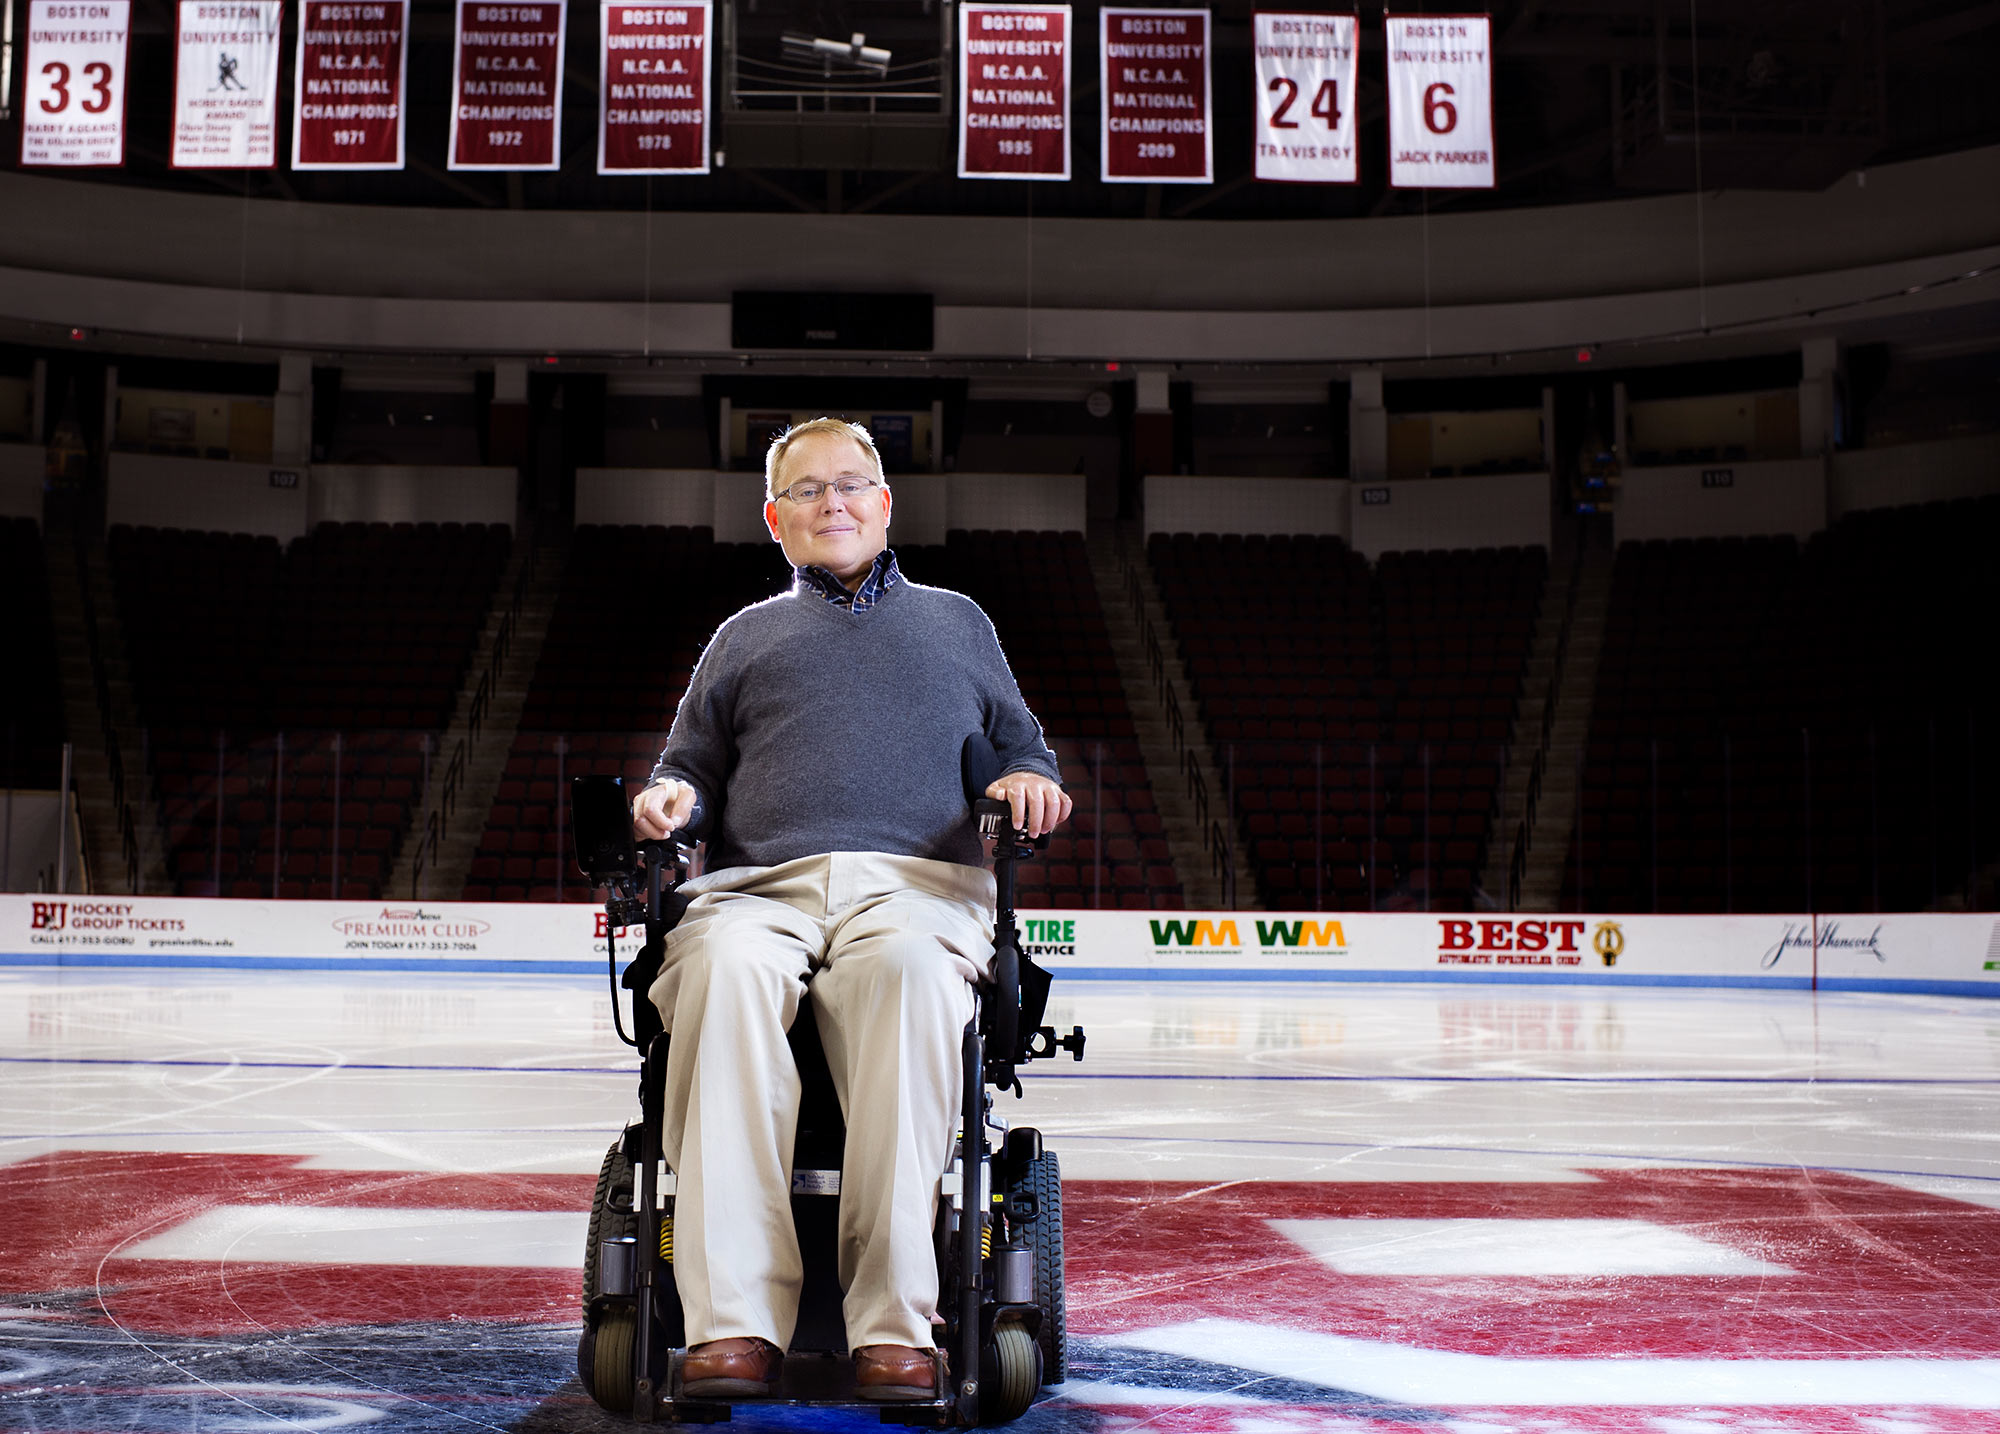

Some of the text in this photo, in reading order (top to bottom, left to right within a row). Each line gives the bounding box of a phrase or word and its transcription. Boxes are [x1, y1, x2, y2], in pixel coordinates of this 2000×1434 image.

[47, 6, 110, 18] BOSTON
[198, 5, 260, 19] BOSTON
[321, 6, 384, 20] BOSTON
[477, 8, 542, 22] BOSTON
[622, 10, 687, 25] BOSTON
[982, 16, 1047, 30] BOSTON
[1122, 20, 1186, 34] BOSTON
[1272, 21, 1335, 35] BOSTON
[32, 30, 126, 44] UNIVERSITY
[182, 31, 276, 45] UNIVERSITY
[306, 31, 400, 45] UNIVERSITY
[1406, 24, 1467, 38] BOSTON
[462, 32, 557, 46] UNIVERSITY
[608, 35, 704, 50] UNIVERSITY
[968, 40, 1064, 56] UNIVERSITY
[1108, 44, 1204, 59] UNIVERSITY
[1259, 46, 1351, 60] UNIVERSITY
[320, 56, 384, 69] N.C.A.A.
[1393, 50, 1485, 64] UNIVERSITY
[476, 58, 540, 71] N.C.A.A.
[622, 60, 688, 74] N.C.A.A.
[982, 65, 1048, 80] N.C.A.A.
[1124, 69, 1188, 84] N.C.A.A.
[40, 62, 112, 114] 33
[308, 80, 390, 94] NATIONAL
[464, 82, 546, 96] NATIONAL
[611, 85, 694, 99] NATIONAL
[972, 90, 1054, 104] NATIONAL
[1114, 93, 1196, 108] NATIONAL
[1269, 77, 1341, 130] 24
[302, 105, 398, 120] CHAMPIONS
[458, 106, 554, 120] CHAMPIONS
[1423, 82, 1458, 134] 6
[608, 110, 702, 124] CHAMPIONS
[968, 114, 1063, 130] CHAMPIONS
[1110, 118, 1204, 134] CHAMPIONS
[333, 130, 365, 145] 1971
[488, 132, 523, 146] 1972
[638, 136, 672, 150] 1978
[998, 140, 1032, 155] 1995
[1138, 143, 1176, 158] 2009
[1260, 144, 1351, 159] TRAVIS ROY
[1395, 150, 1489, 164] JACK PARKER
[32, 902, 67, 930] BU
[72, 904, 133, 915] HOCKEY
[72, 918, 185, 931] GROUP TICKETS
[344, 922, 478, 938] PREMIUM CLUB
[1025, 920, 1075, 942] TIRE
[30, 936, 54, 944] CALL
[1150, 920, 1240, 946] WM
[1256, 920, 1346, 946] WM
[1438, 920, 1584, 951] BEST
[345, 941, 368, 949] JOIN
[372, 942, 404, 950] TODAY
[1021, 946, 1075, 955] ERVICE
[1760, 920, 1814, 970] John
